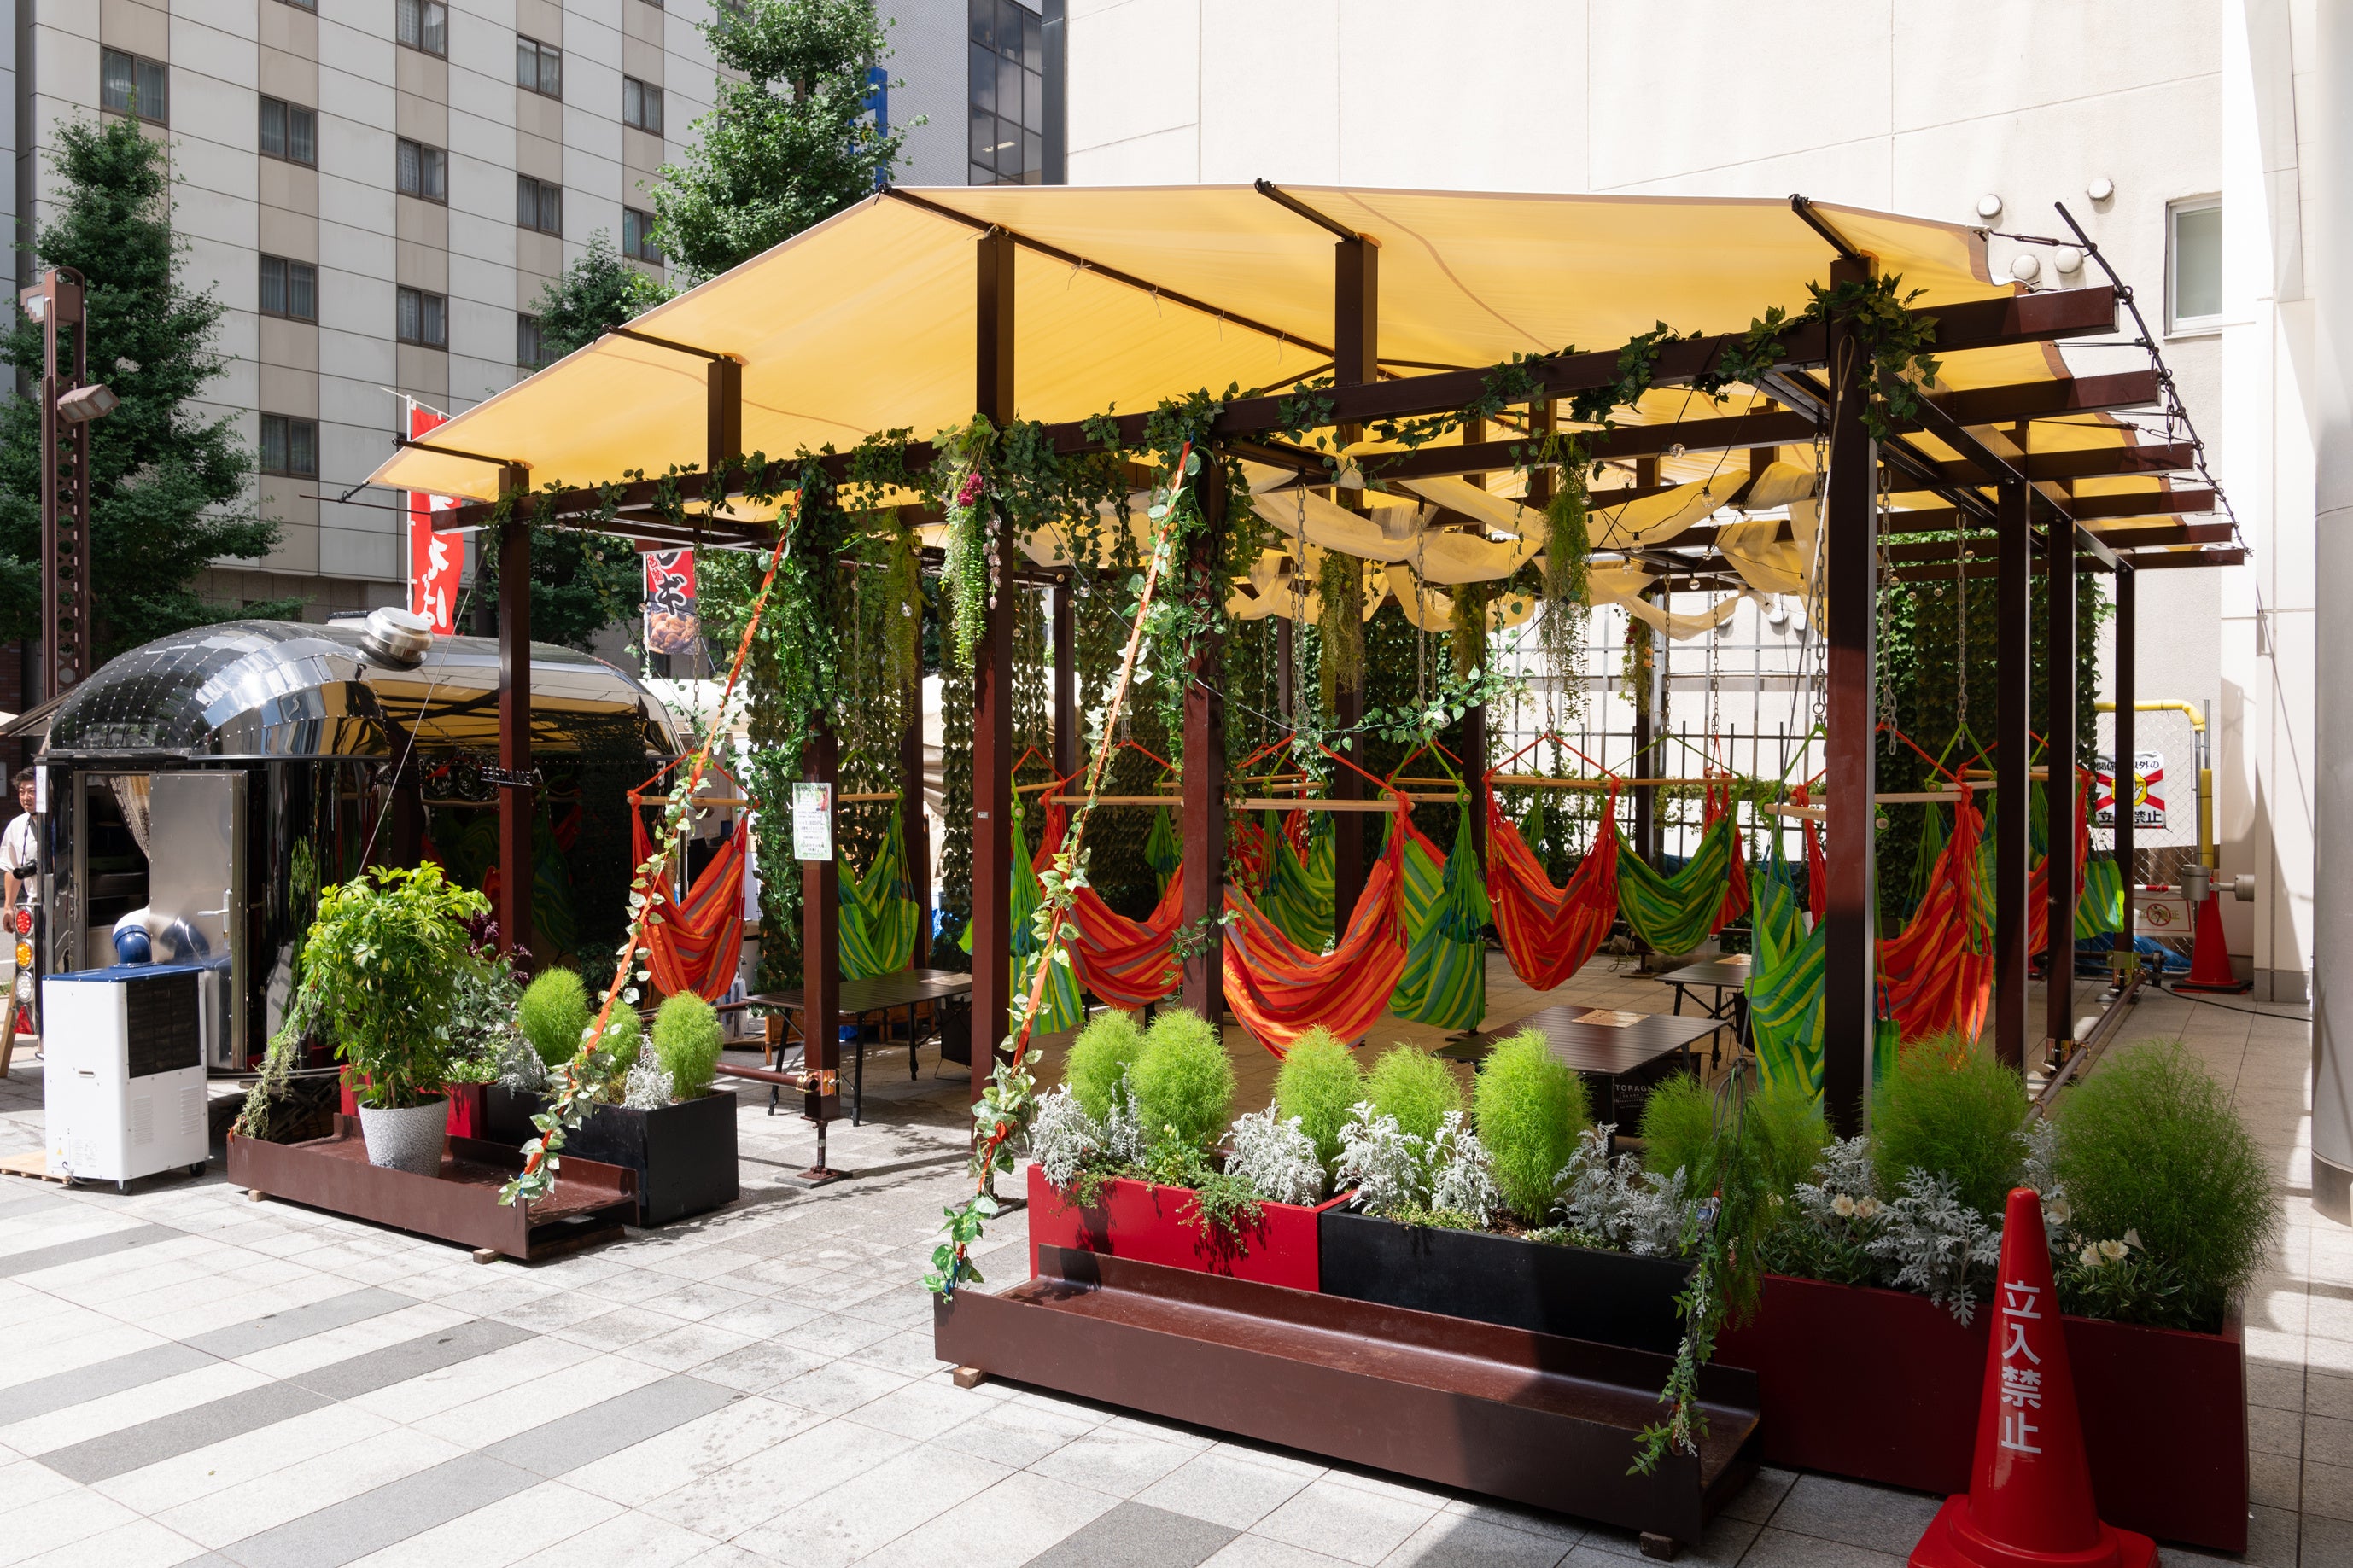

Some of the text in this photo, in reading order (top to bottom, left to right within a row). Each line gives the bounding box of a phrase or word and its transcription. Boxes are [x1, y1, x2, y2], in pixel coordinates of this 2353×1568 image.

[2098, 810, 2163, 823] 立禁止
[2001, 1280, 2041, 1454] 立入禁止
